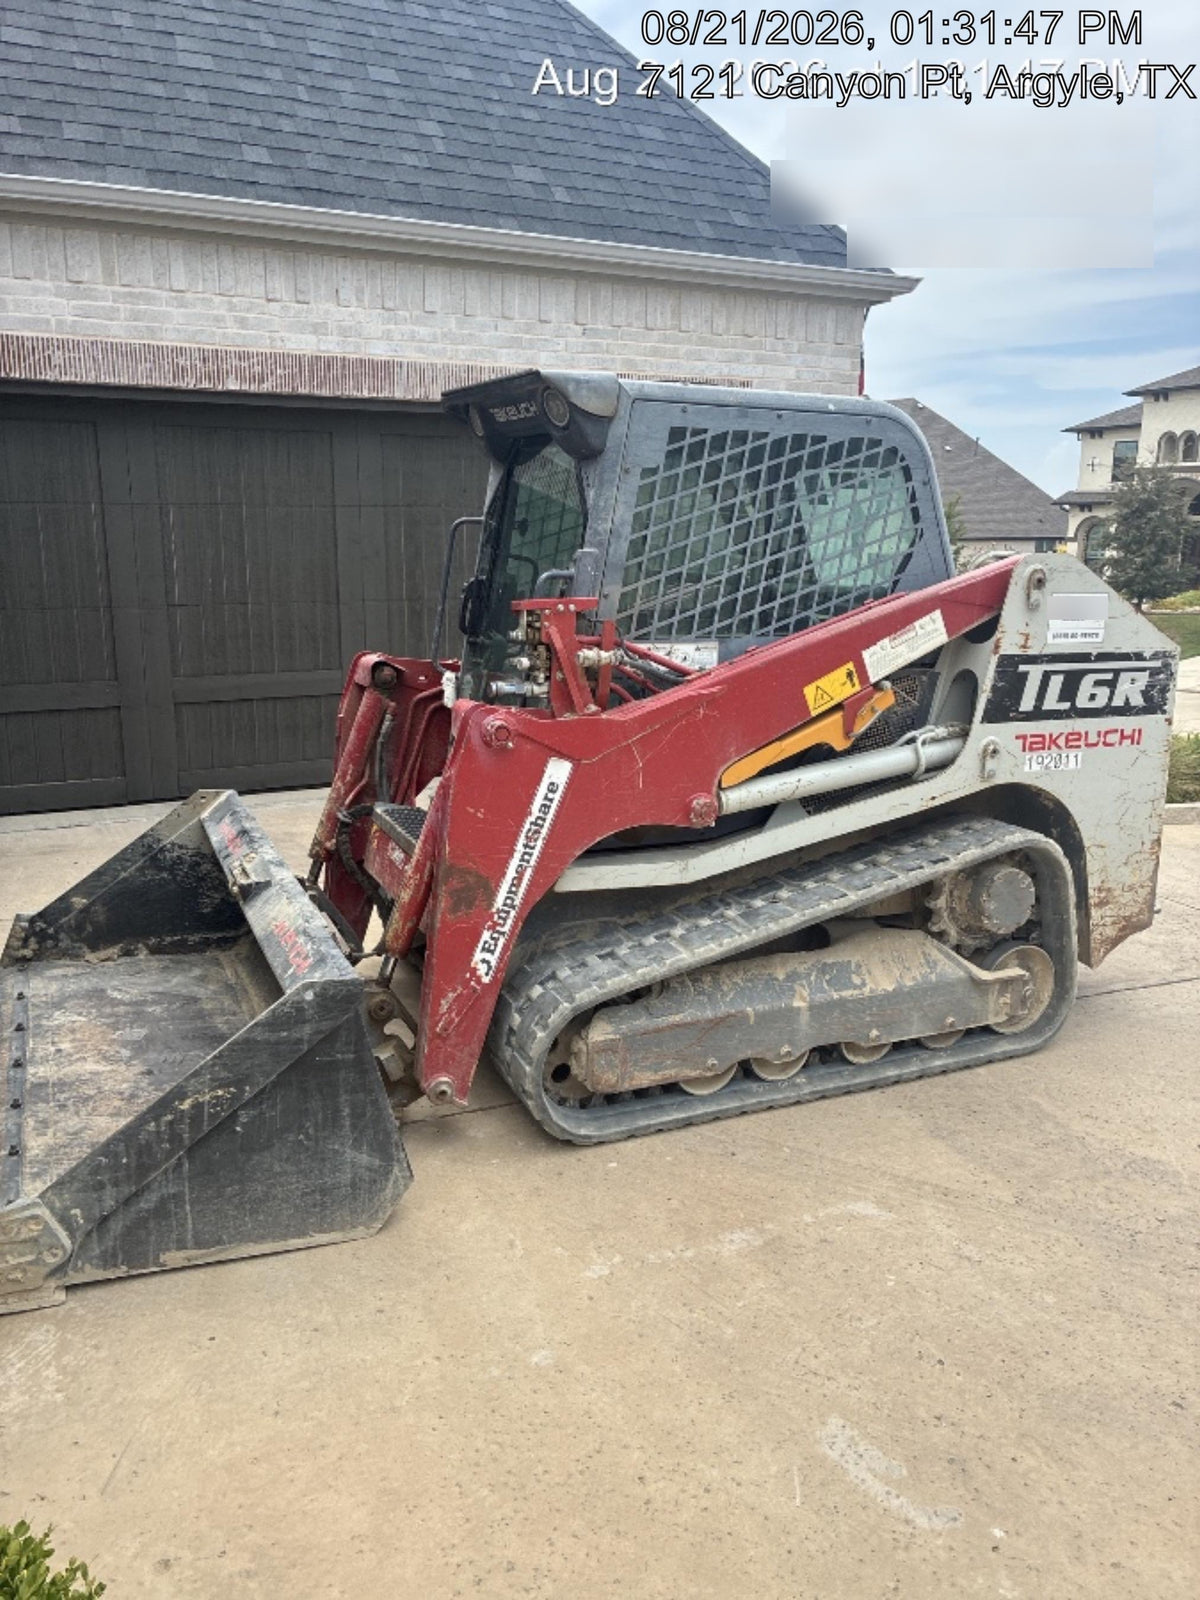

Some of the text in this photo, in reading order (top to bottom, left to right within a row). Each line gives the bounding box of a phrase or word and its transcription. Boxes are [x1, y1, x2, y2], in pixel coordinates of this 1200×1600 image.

[1016, 660, 1163, 712] TL6R
[1014, 728, 1143, 752] TAKEUCHI
[479, 780, 560, 957] EquipmentShare
